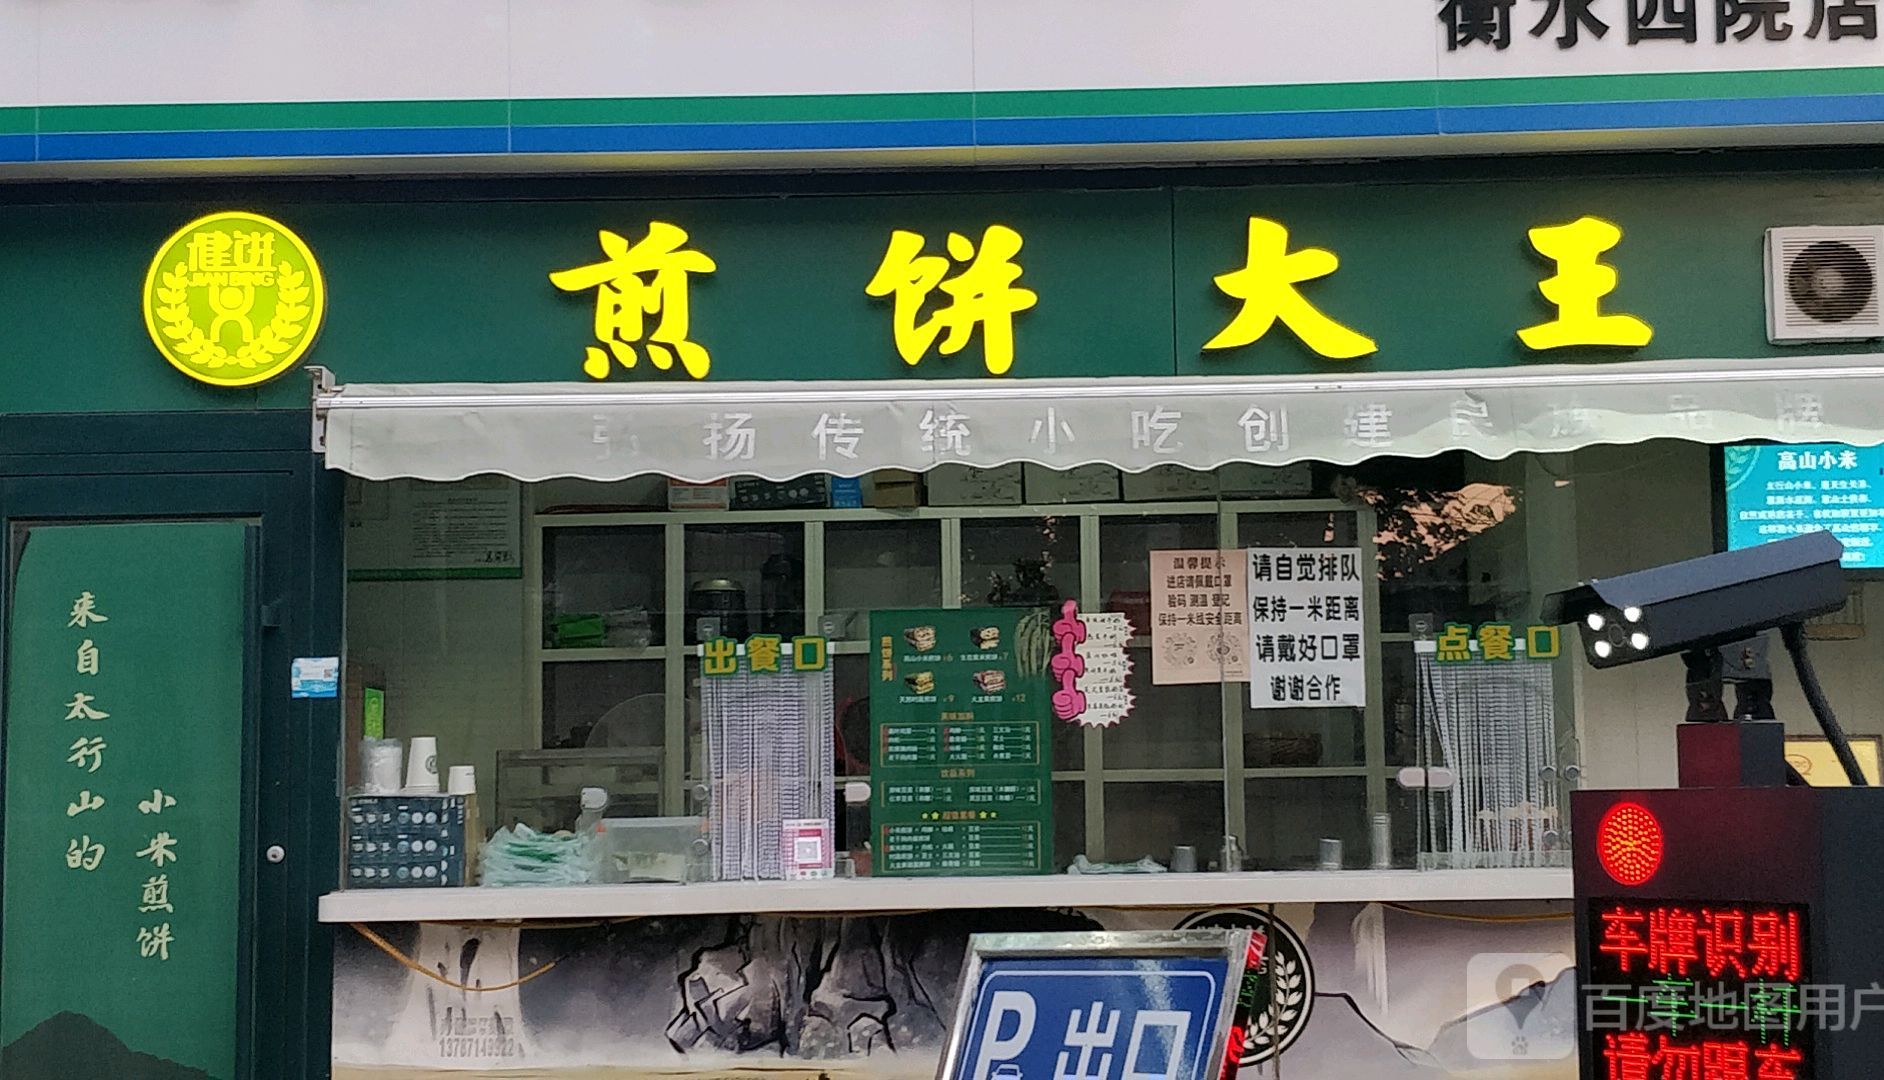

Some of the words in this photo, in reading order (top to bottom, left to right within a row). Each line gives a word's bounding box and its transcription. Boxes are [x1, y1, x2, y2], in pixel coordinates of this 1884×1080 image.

[549, 216, 1656, 379] 煎饼大王
[1777, 449, 1858, 471] 高山小米
[1172, 556, 1227, 571] 温馨提示
[1252, 552, 1361, 583] 请自觉排队
[1166, 574, 1233, 589] 进店请佩戴口罩
[1167, 594, 1187, 608] 验码
[1189, 594, 1209, 608] 测温
[1211, 593, 1231, 608] 登记
[1252, 595, 1360, 623] 保持一米距离
[1158, 611, 1243, 627] 保持一米线安全距离
[702, 634, 828, 675] 出餐口
[1255, 633, 1361, 664] 请戴好口罩
[1437, 622, 1560, 662] 点餐口
[1270, 674, 1342, 702] 谢谢合作
[64, 590, 111, 872] 来自太行山的
[136, 788, 178, 962] 小米煎饼
[1599, 906, 1802, 982] 车牌识别
[975, 990, 1037, 1080] P
[1054, 1001, 1192, 1080] 出口
